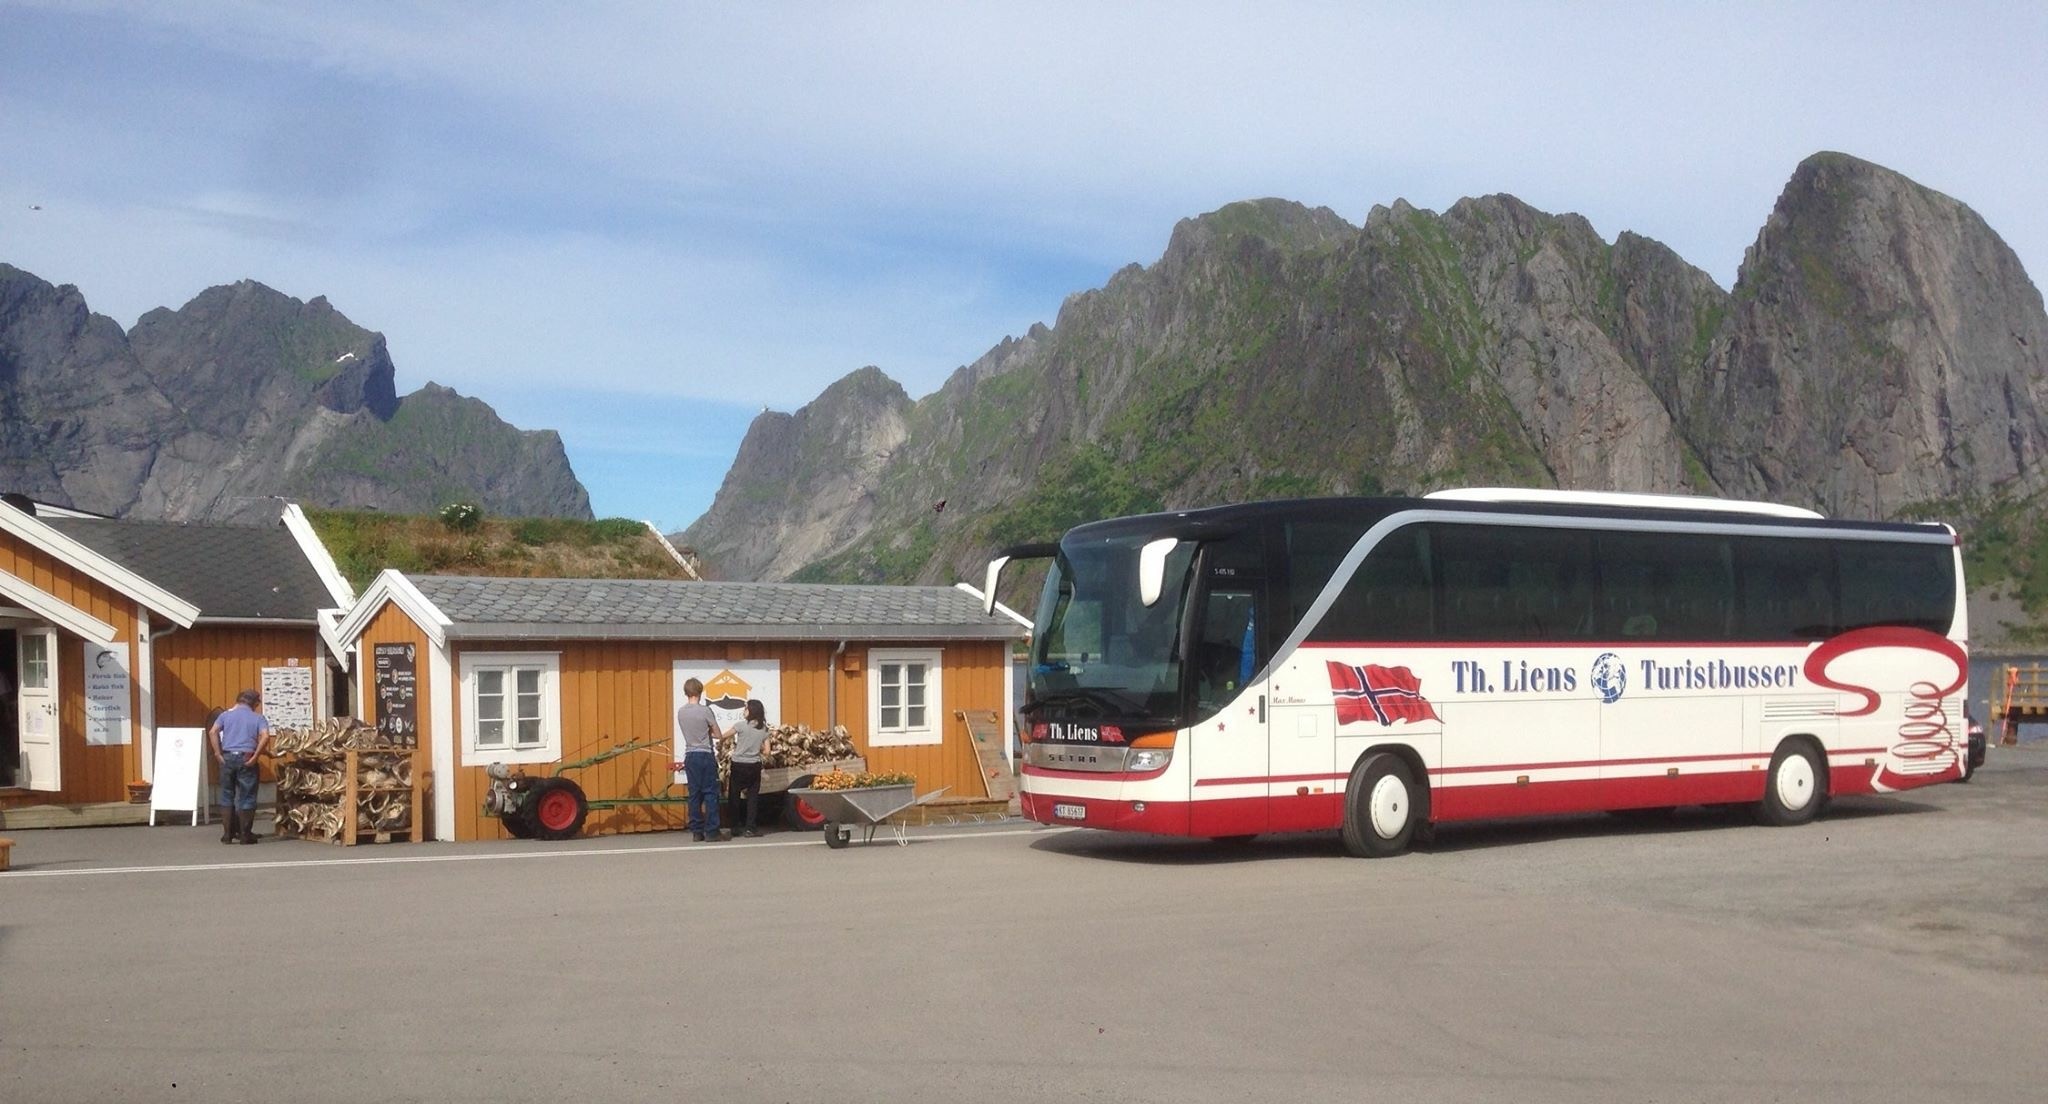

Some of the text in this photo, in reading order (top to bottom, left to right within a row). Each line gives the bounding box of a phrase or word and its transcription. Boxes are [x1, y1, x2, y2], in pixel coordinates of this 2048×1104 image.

[1452, 659, 1798, 693] Th. Liens Turistbusser
[1050, 723, 1098, 741] Th. Liens
[1048, 753, 1097, 764] SETRA
